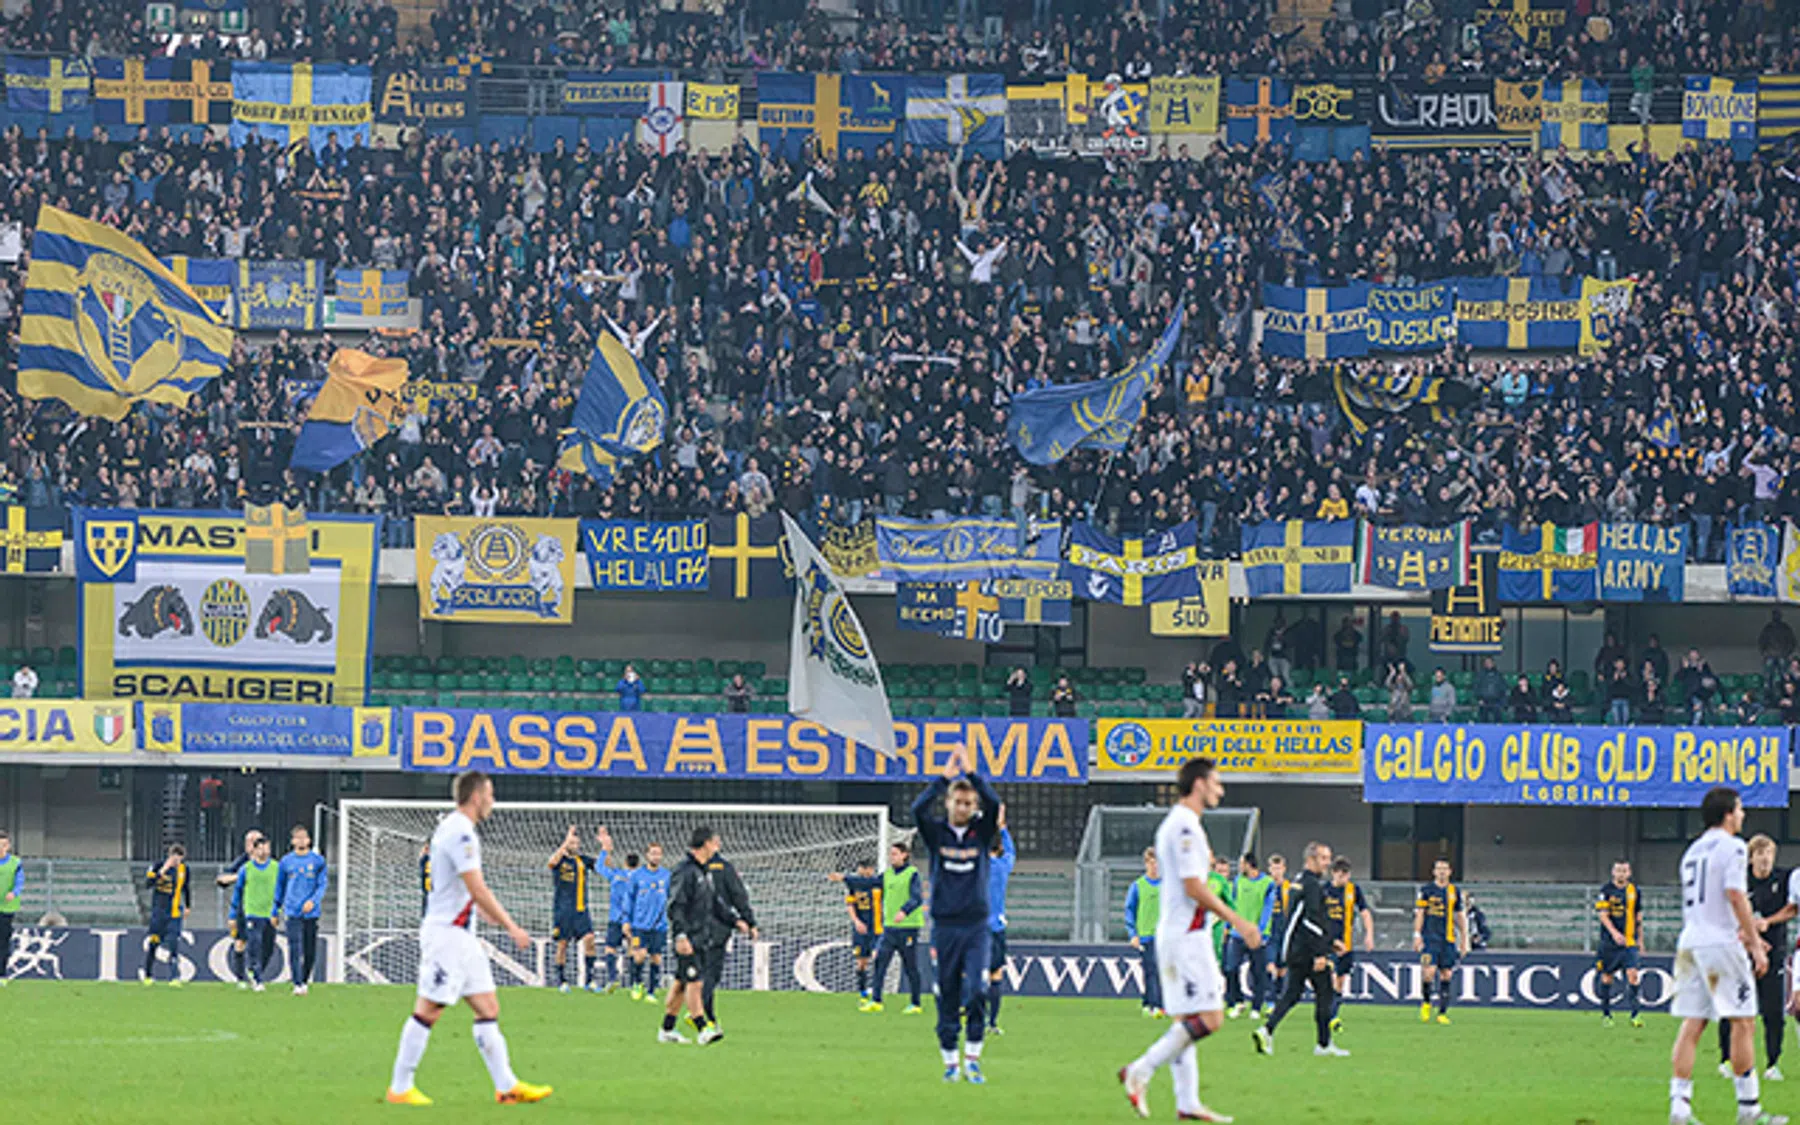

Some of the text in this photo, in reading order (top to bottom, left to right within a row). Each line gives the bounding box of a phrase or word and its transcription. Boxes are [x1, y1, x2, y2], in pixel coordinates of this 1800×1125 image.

[1686, 94, 1753, 119] BOVOLONE
[137, 525, 320, 552] MASI
[1376, 526, 1454, 543] VERONA
[1601, 523, 1683, 554] HELLAS
[1603, 558, 1664, 590] ARMY
[1172, 610, 1209, 627] SUD
[113, 673, 333, 706] SCALIGERI
[299, 733, 350, 748] GARDA
[412, 712, 648, 770] BASSA
[1192, 723, 1323, 734] CALCIO CLUB
[1171, 734, 1219, 752] LUPI
[1275, 737, 1354, 754] HELLAS
[1502, 731, 1581, 781] CLUB
[1685, 857, 1707, 907] 21
